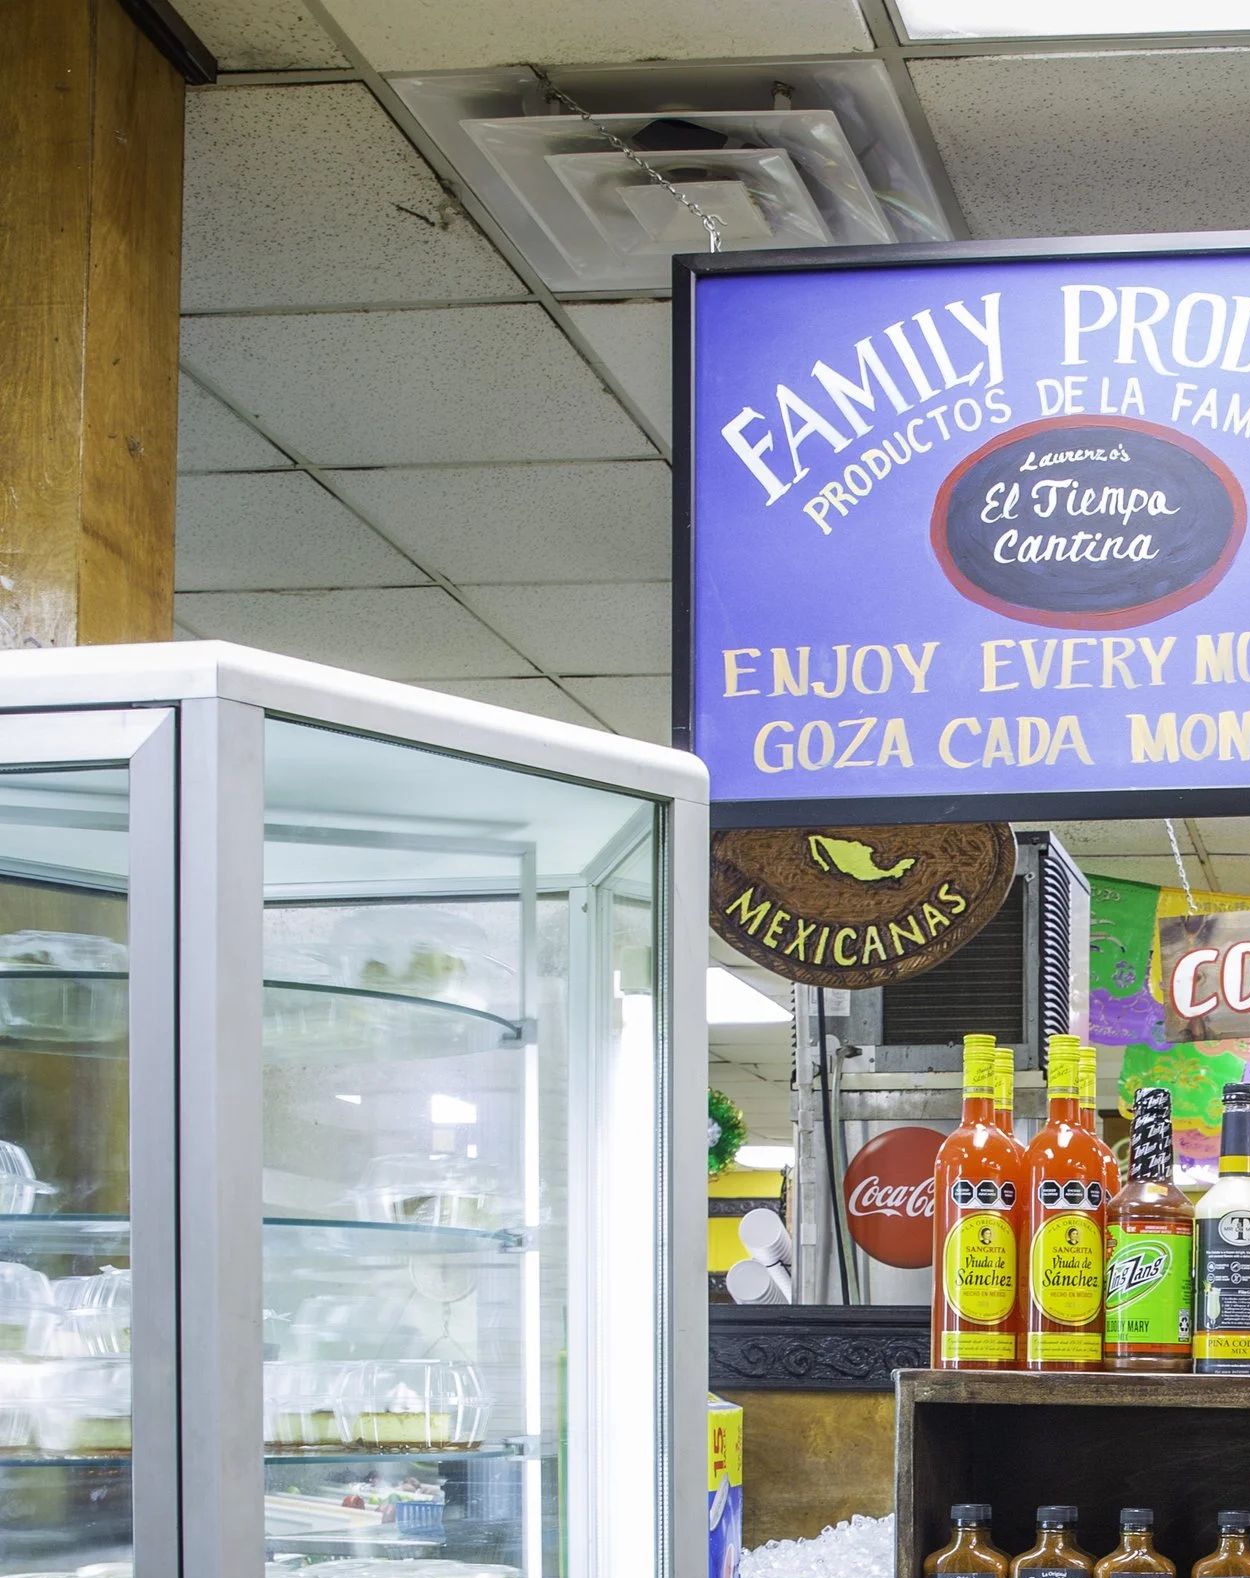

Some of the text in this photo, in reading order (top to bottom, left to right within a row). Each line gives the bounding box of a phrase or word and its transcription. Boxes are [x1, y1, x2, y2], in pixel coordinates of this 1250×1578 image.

[720, 292, 1002, 507] FAMILY
[802, 388, 1013, 535] PRODUCTOS
[1036, 377, 1087, 416] DE
[1100, 376, 1145, 415] LA
[980, 479, 1019, 523] El
[993, 527, 1159, 565] Cantina
[722, 641, 940, 699] ENJOY
[980, 636, 1186, 692] EVERY
[753, 716, 914, 773] GOZA
[938, 715, 1093, 769] CADA
[726, 884, 966, 966] MEXICANAS
[955, 1269, 1012, 1286] Sánchez
[965, 1255, 1005, 1268] Viuda de
[1042, 1270, 1097, 1287] Sánchez
[1052, 1256, 1092, 1269] Viuda de
[1127, 1320, 1149, 1333] MARY
[1208, 1339, 1230, 1347] PIÑA
